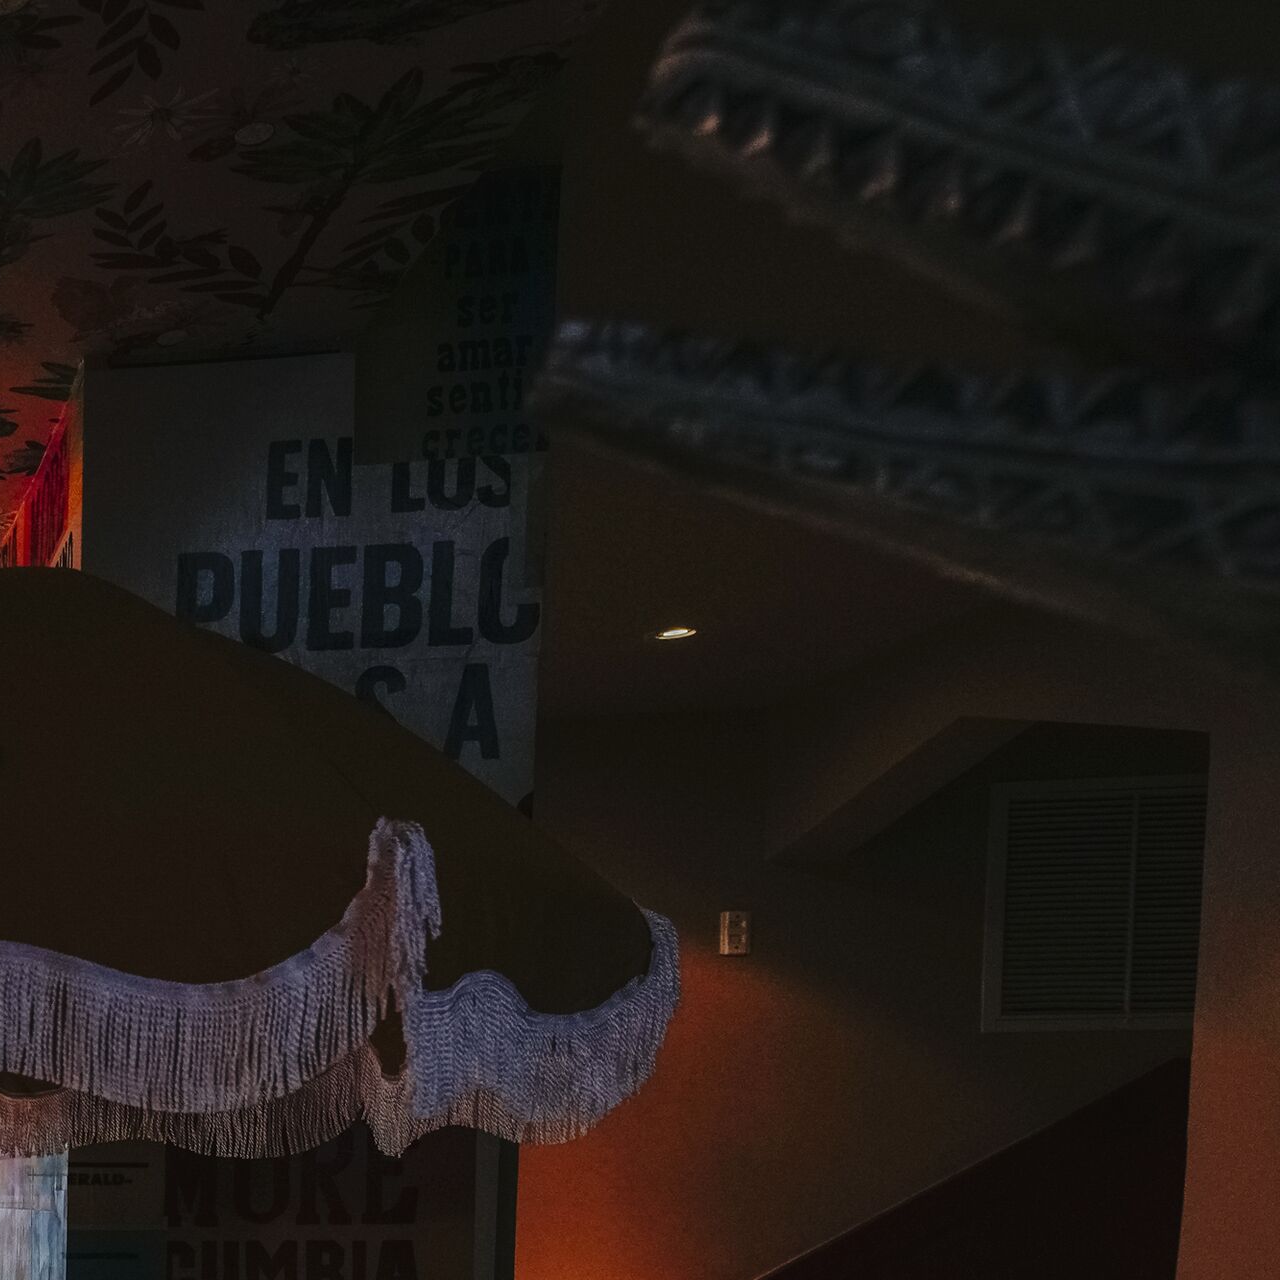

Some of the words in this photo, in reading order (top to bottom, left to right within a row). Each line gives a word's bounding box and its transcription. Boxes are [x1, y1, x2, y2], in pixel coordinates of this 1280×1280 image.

[456, 292, 519, 328] ser
[436, 334, 533, 372] amar
[426, 369, 525, 417] senti
[266, 438, 353, 520] EN
[390, 455, 511, 514] LOS
